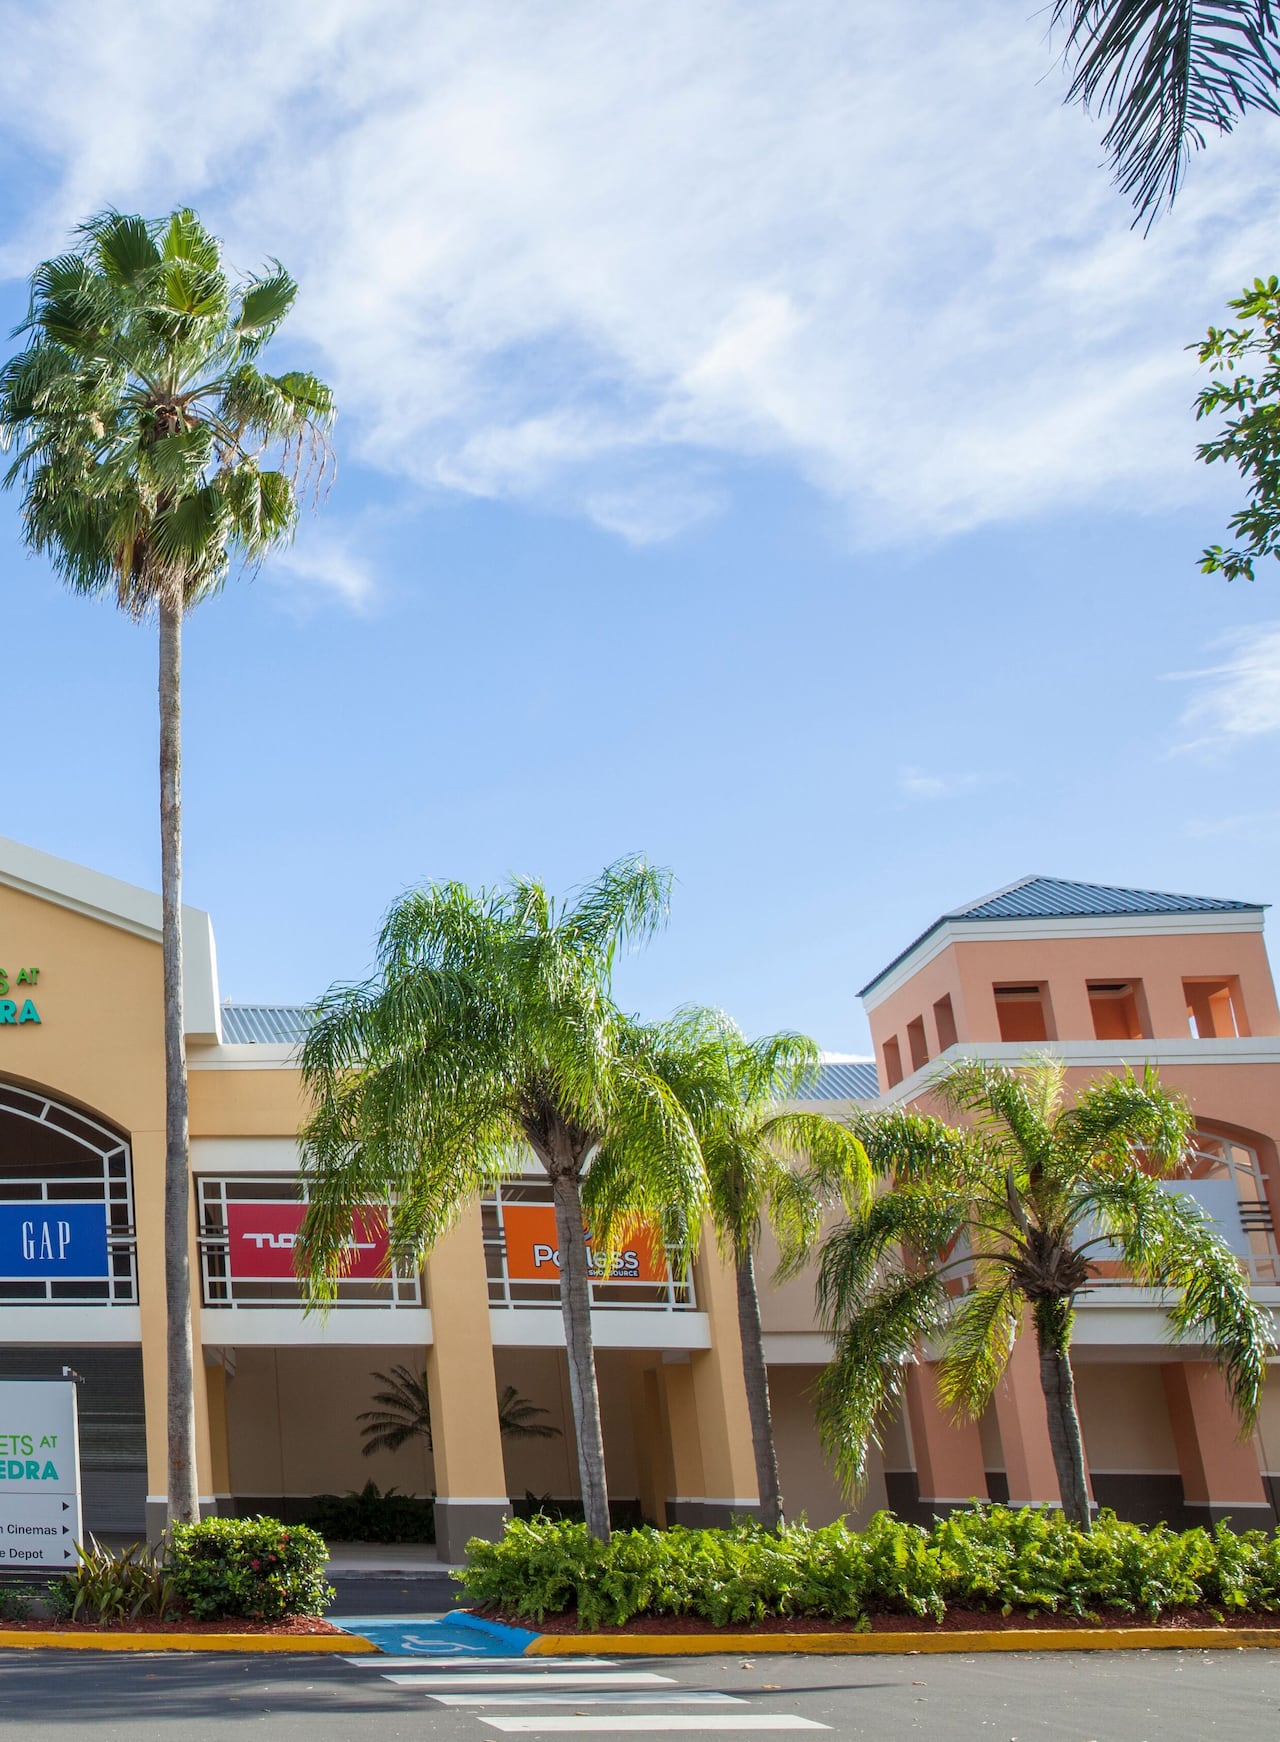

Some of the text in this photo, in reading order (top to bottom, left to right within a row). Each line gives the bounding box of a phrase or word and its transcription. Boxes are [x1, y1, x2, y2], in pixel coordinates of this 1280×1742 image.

[16, 967, 40, 986] AT
[22, 1220, 71, 1261] GAP
[533, 1243, 640, 1270] Pless
[588, 1269, 640, 1277] SHOSOURCE
[39, 1435, 58, 1449] AT
[7, 1523, 58, 1536] Cinemas
[9, 1548, 44, 1561] Depot
